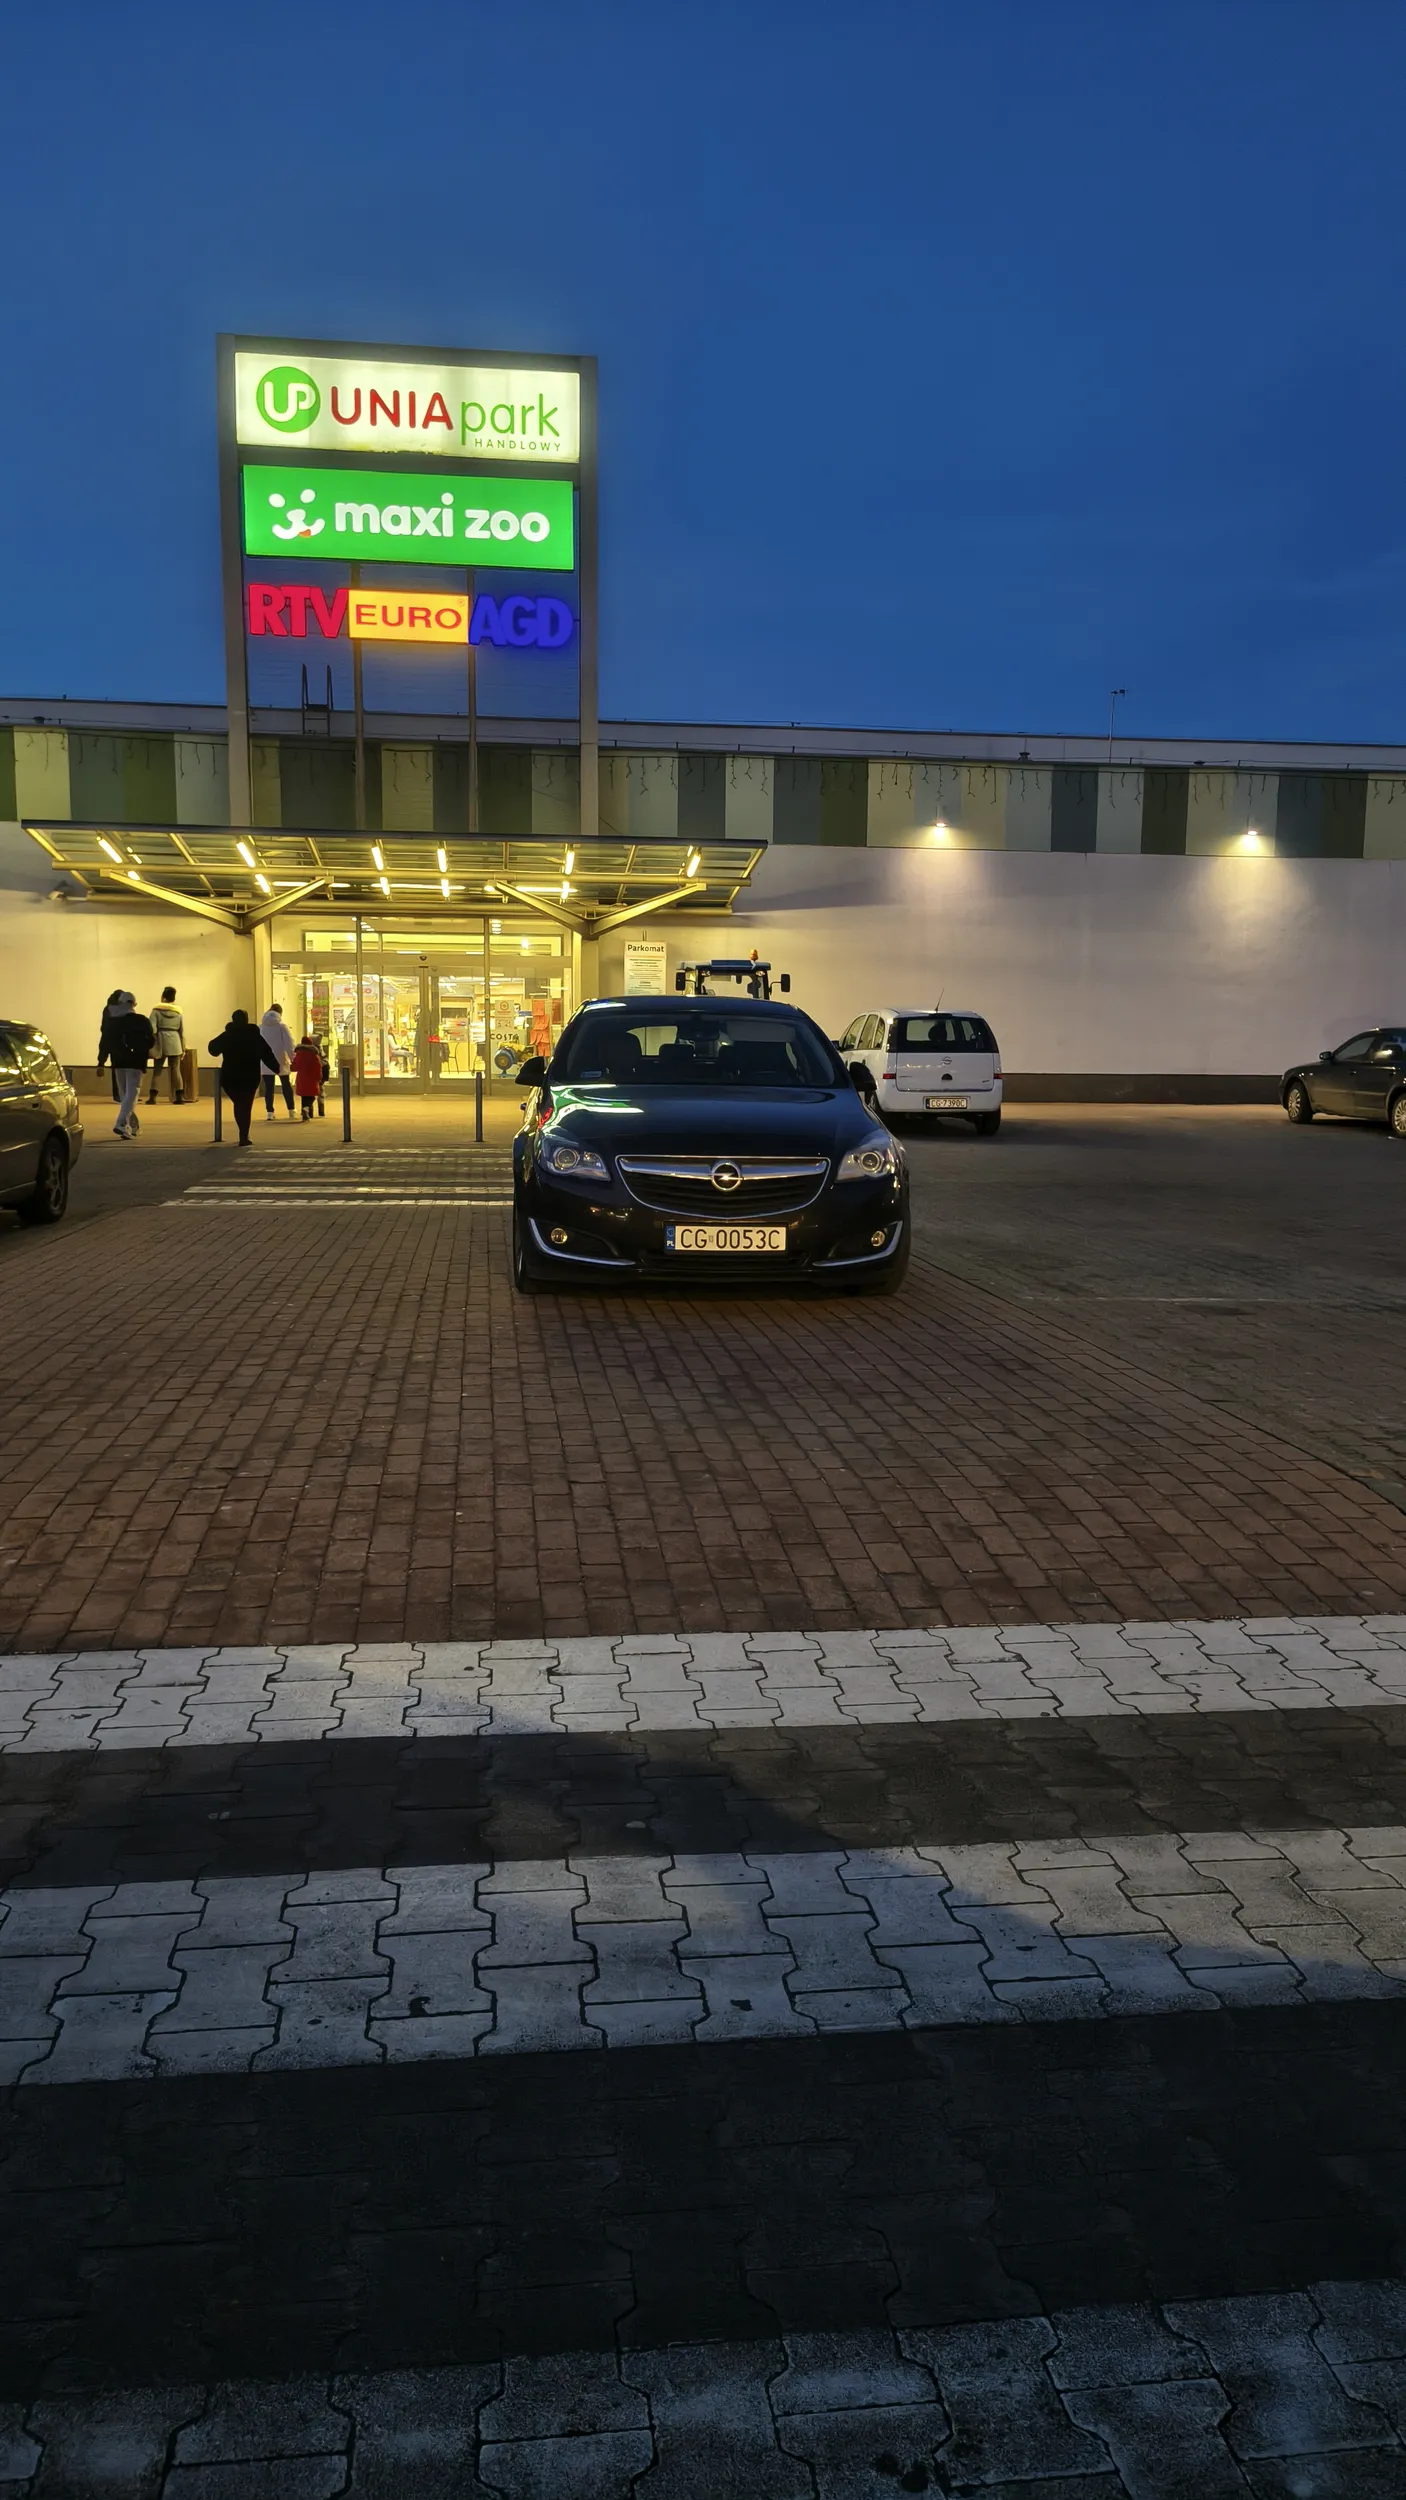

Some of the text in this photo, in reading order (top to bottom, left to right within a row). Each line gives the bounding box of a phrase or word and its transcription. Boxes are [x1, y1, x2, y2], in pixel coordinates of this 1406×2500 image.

[331, 386, 560, 445] UNIA park
[475, 438, 561, 451] HANDLOWY
[335, 492, 550, 542] maxi zoo
[249, 584, 575, 648] RTV EURO AGD
[627, 944, 664, 953] Parkomat
[680, 1229, 780, 1249] CG 0053C
